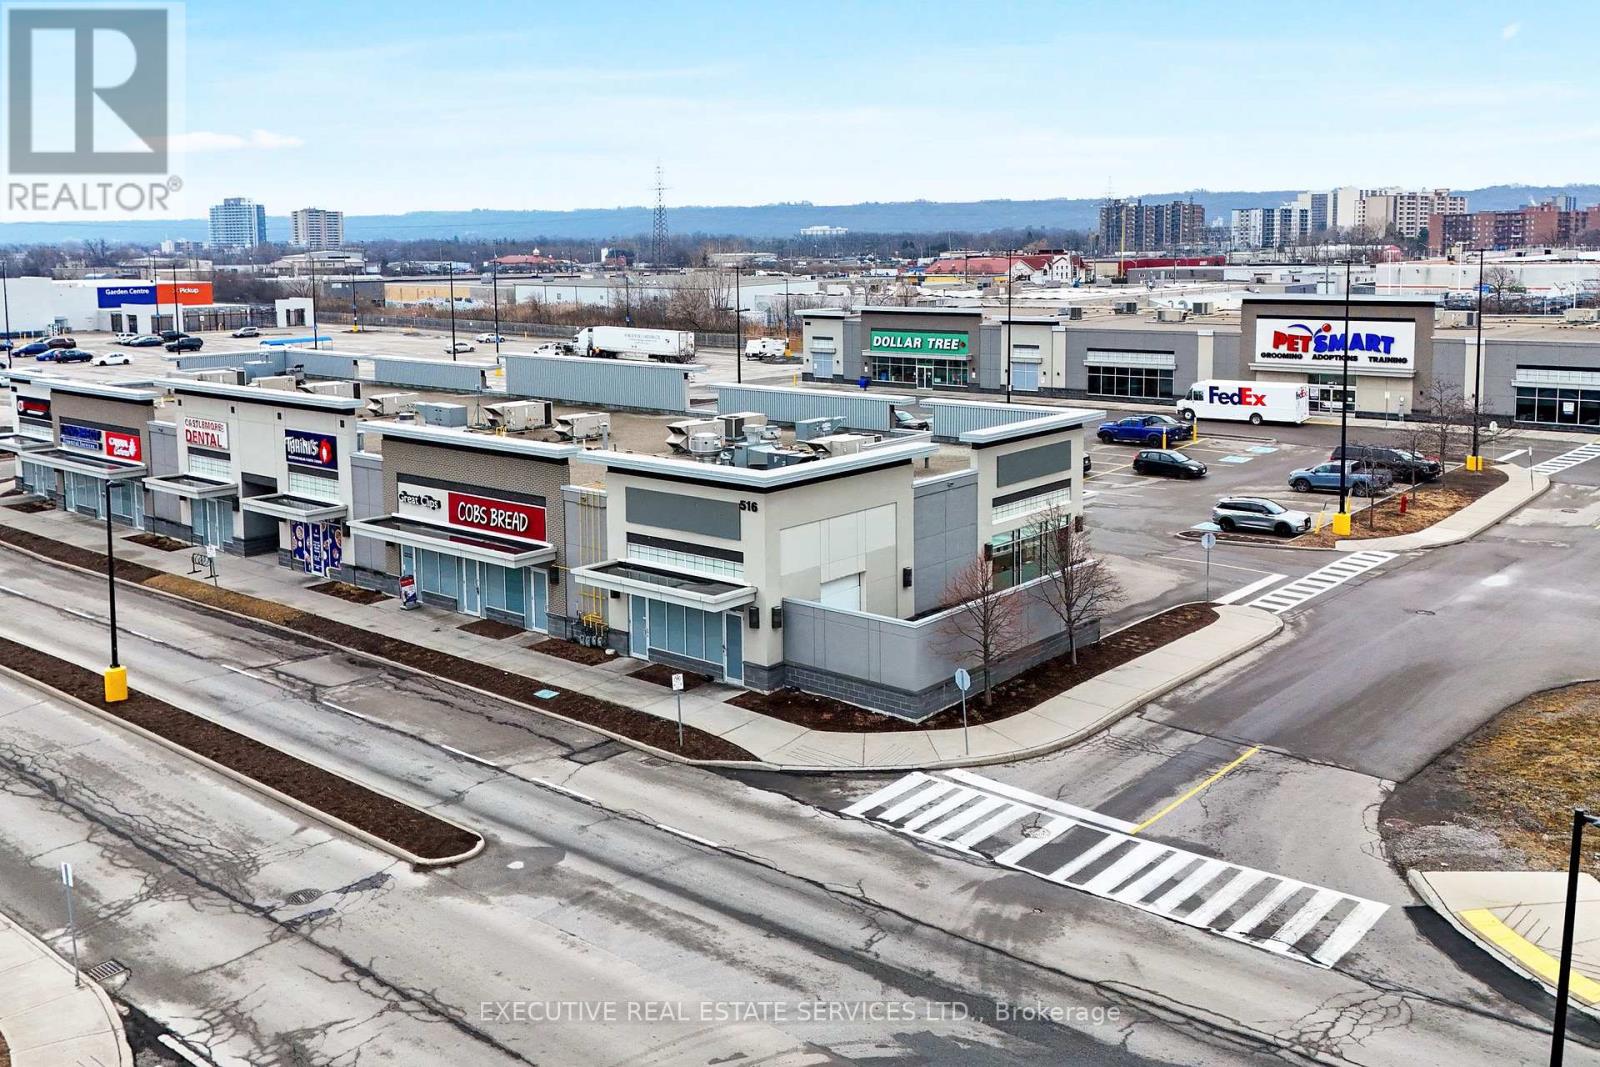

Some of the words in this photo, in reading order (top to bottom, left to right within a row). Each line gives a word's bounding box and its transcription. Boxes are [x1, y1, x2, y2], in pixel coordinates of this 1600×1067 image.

[873, 336, 922, 348] DOLLAR
[927, 338, 960, 350] TREE
[1261, 352, 1303, 360] GROOMING
[1368, 356, 1408, 364] TRAINING
[1209, 386, 1267, 406] FedEx
[185, 429, 222, 448] DENTAL
[399, 490, 421, 505] Great
[421, 494, 441, 510] Clips
[740, 500, 758, 512] 516
[458, 501, 487, 524] COBS
[490, 507, 528, 532] BREAD
